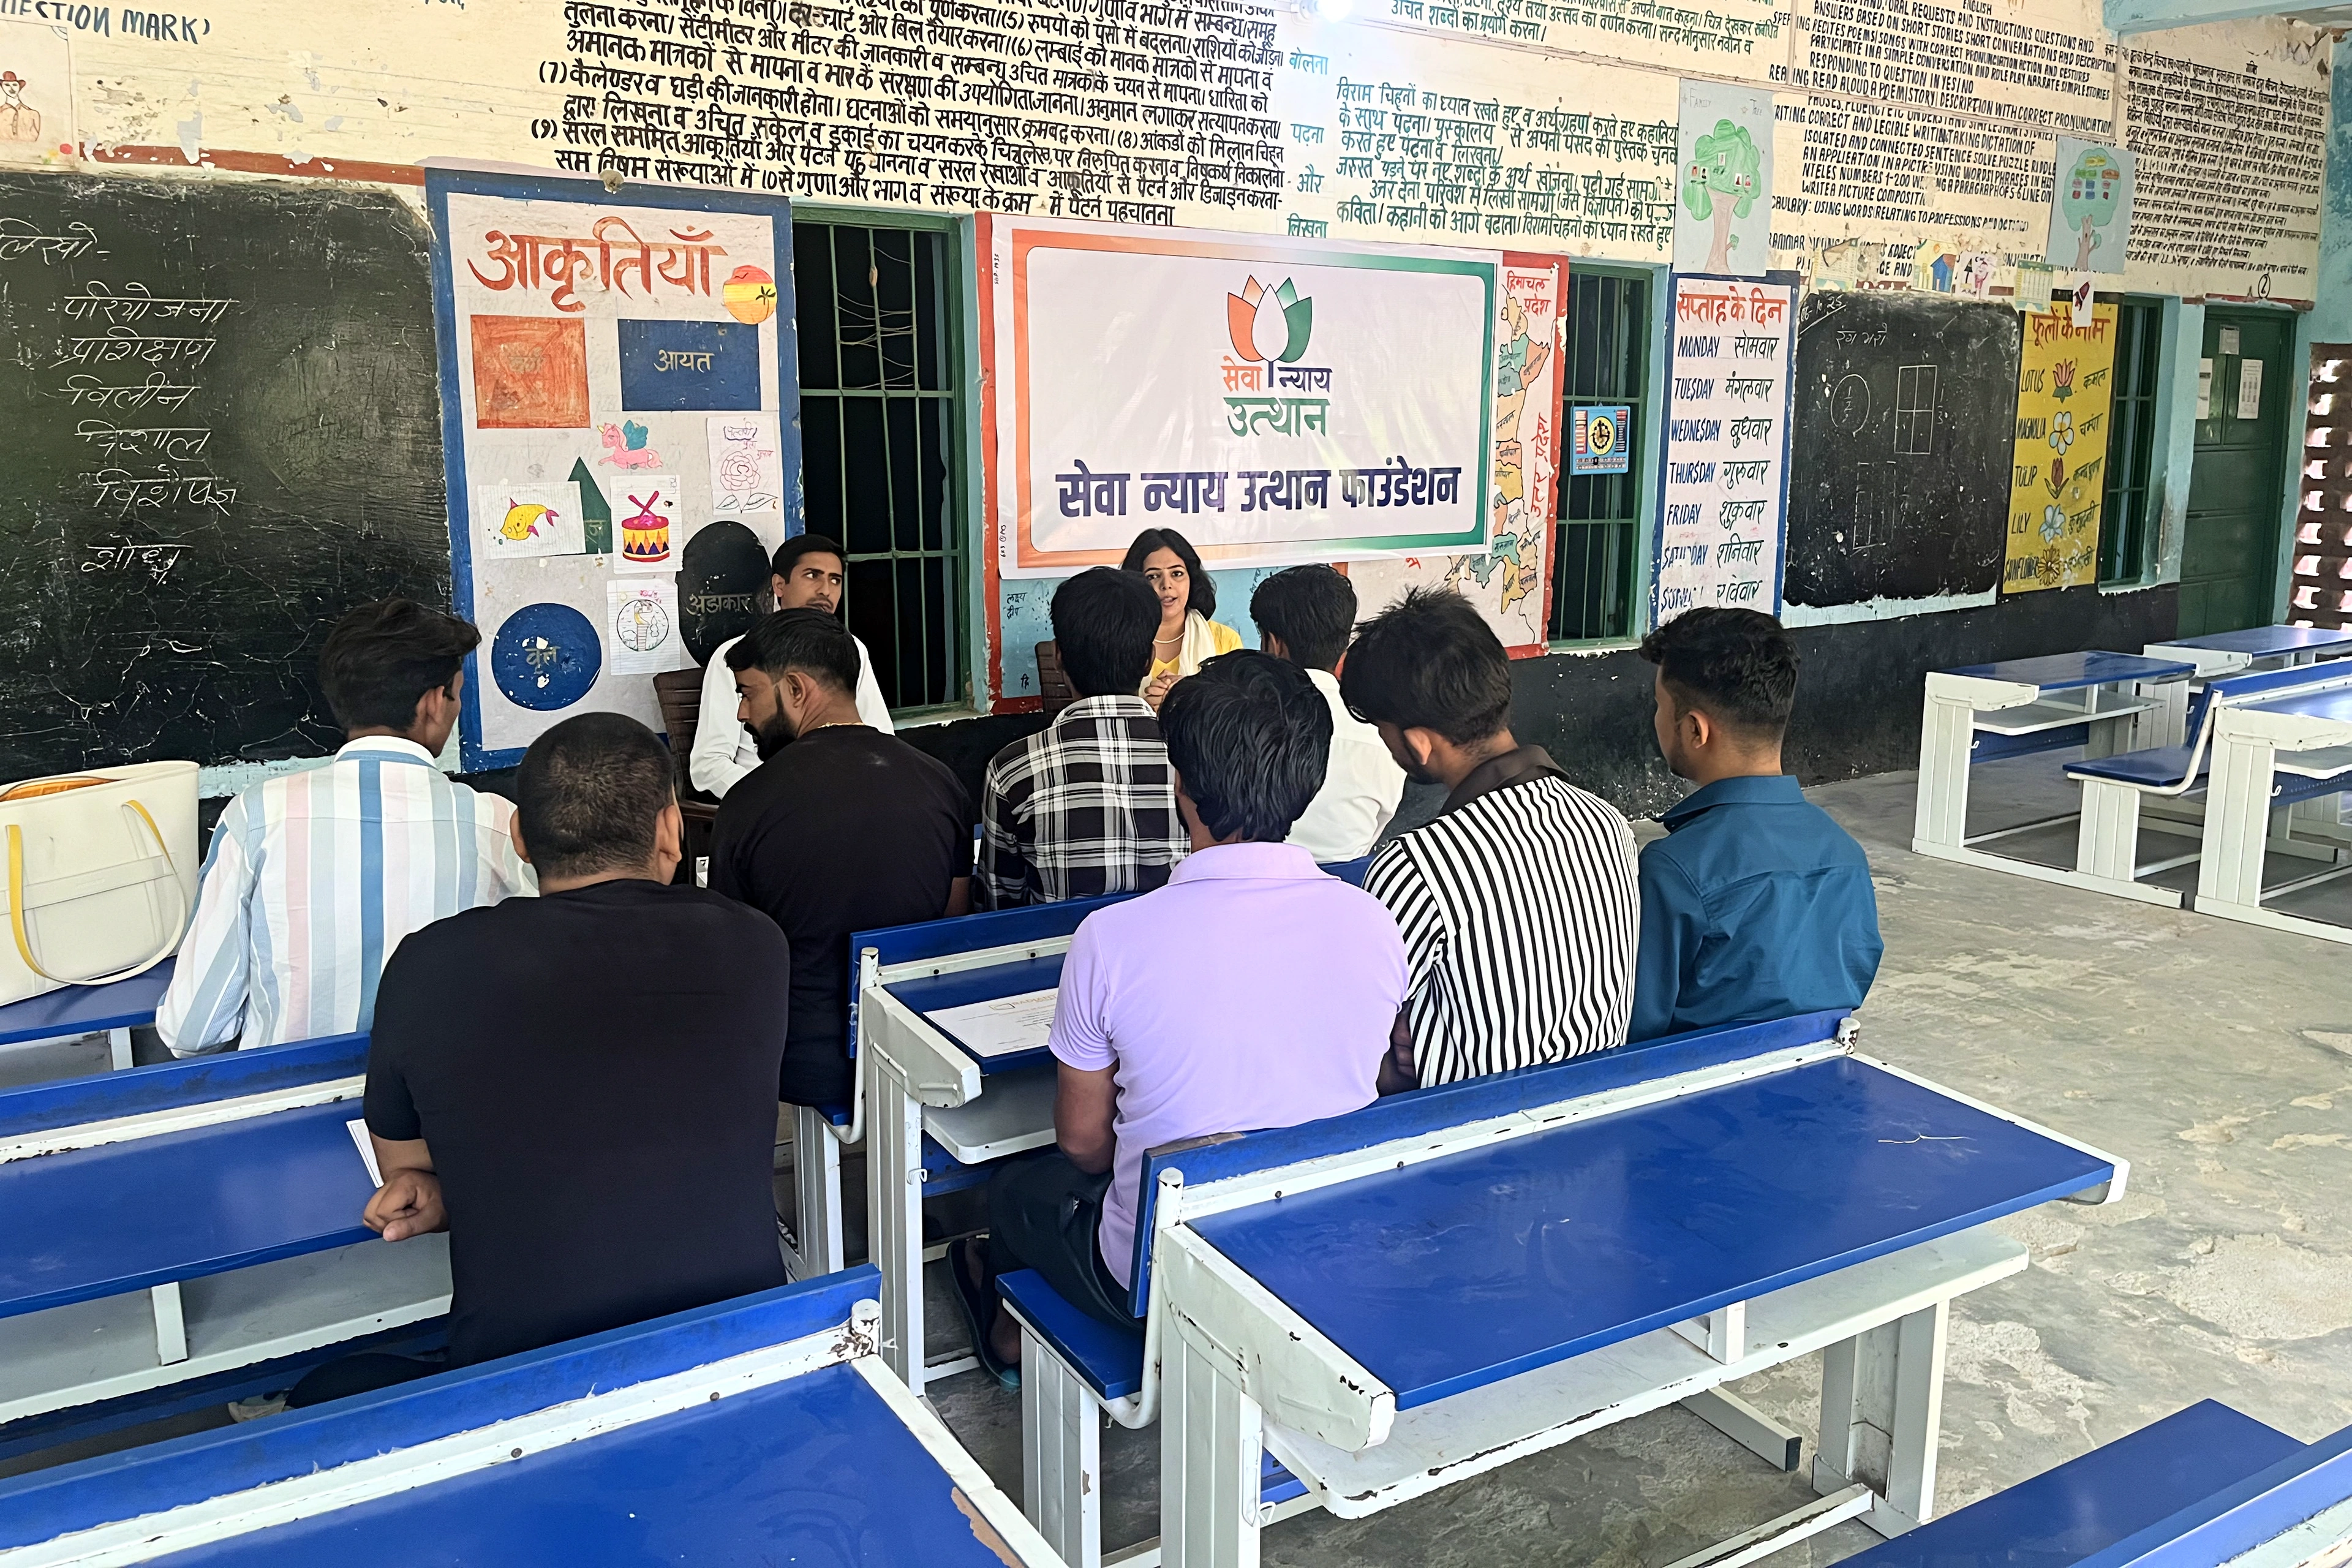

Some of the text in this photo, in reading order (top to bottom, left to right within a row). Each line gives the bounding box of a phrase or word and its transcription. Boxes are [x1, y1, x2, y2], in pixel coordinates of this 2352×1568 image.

[564, 1, 616, 28] तुलना
[892, 13, 923, 43] बिल
[1071, 15, 1089, 39] को
[1856, 9, 1991, 50] BASED ON SHORT STORIES SHORT
[1912, 2, 1956, 24] REQUESTS
[1958, 12, 1973, 28] AND
[1976, 17, 2032, 41] INSTRUCTIONS
[1811, 34, 1863, 56] PARTICIPATE
[1865, 43, 1874, 58] IN
[1884, 47, 1913, 65] SIMPLE
[1813, 20, 1844, 37] RECITES
[1908, 37, 1929, 52] WITH
[567, 29, 1137, 122] अमानक से मापना व भार की अनुमान
[792, 29, 833, 56] मीटर
[834, 34, 859, 59] की
[861, 43, 931, 70] जानकारी
[933, 54, 950, 71] व
[1009, 61, 1048, 85] उचित
[1114, 77, 1144, 99] चयन
[1147, 76, 1161, 100] से
[1251, 92, 1268, 113] को
[1085, 43, 1107, 66] को
[1110, 50, 1149, 74] मानक
[1200, 60, 1217, 83] से
[1218, 66, 1260, 89] मापना
[1810, 51, 1927, 87] RESPONDING TO QUESTION
[1812, 70, 1838, 89] READ
[602, 91, 747, 135] लिखना व उचित
[646, 75, 666, 95] व
[706, 75, 734, 105] की
[734, 85, 799, 114] जानकारी
[846, 98, 907, 125] घटनाओं
[908, 101, 930, 127] को
[935, 108, 1021, 138] समयानुसार
[1118, 129, 1137, 149] (8)
[1187, 132, 1206, 156] को
[1422, 91, 1438, 111] का
[1440, 96, 1471, 116] ध्यान
[562, 121, 606, 146] सरल
[1355, 108, 1388, 130] साथ
[1874, 119, 1910, 137] LEGIBLE
[878, 129, 948, 153] का चयन
[1804, 129, 1972, 164] ISOLATED AND SENTENCE
[2024, 140, 2035, 156] OF
[741, 162, 760, 187] में
[778, 165, 795, 193] से
[796, 171, 837, 197] गुणा
[873, 179, 908, 203] भाग
[910, 183, 928, 204] व
[982, 184, 1003, 209] के
[1002, 192, 1039, 214] क्रम
[1049, 190, 1064, 216] में
[1297, 164, 1325, 193] और
[1838, 185, 1874, 201] PICTURE
[1387, 202, 1482, 233] कहानी आगे
[1814, 202, 1841, 216] USING
[467, 216, 728, 312] आकृतियाँ
[1507, 270, 1550, 293] हिमाचल
[1523, 293, 1551, 316] प्रदेश
[1677, 293, 1730, 327] सप्ताह
[1730, 285, 1747, 322] के
[1749, 287, 1788, 330] दिन
[2031, 306, 2061, 350] फूलों
[2062, 305, 2073, 341] के
[1678, 336, 1720, 358] MONDAY
[1735, 330, 1779, 361] सोमवार
[654, 350, 715, 372] आयत
[1221, 356, 1332, 393] सेवा न्याय
[1675, 378, 1714, 401] TUESDAY
[1725, 371, 1774, 403] मंगलवार
[2021, 369, 2045, 393] LOTUS
[1223, 396, 1330, 437] उत्थान
[1671, 418, 1721, 443] WEDNESDAY
[1730, 416, 1773, 448] बुधवार
[1056, 455, 1462, 518] सेवा न्याय उत्थान फाउंडेशन
[1669, 461, 1716, 484] THURSDAY
[1723, 460, 1771, 489] गुरुवार
[2015, 466, 2037, 487] TULIP
[1667, 503, 1702, 526] FRIDAY
[1719, 500, 1768, 530] शुक्रवार
[2011, 512, 2030, 534] LILY
[1717, 533, 1764, 568] शनिवार
